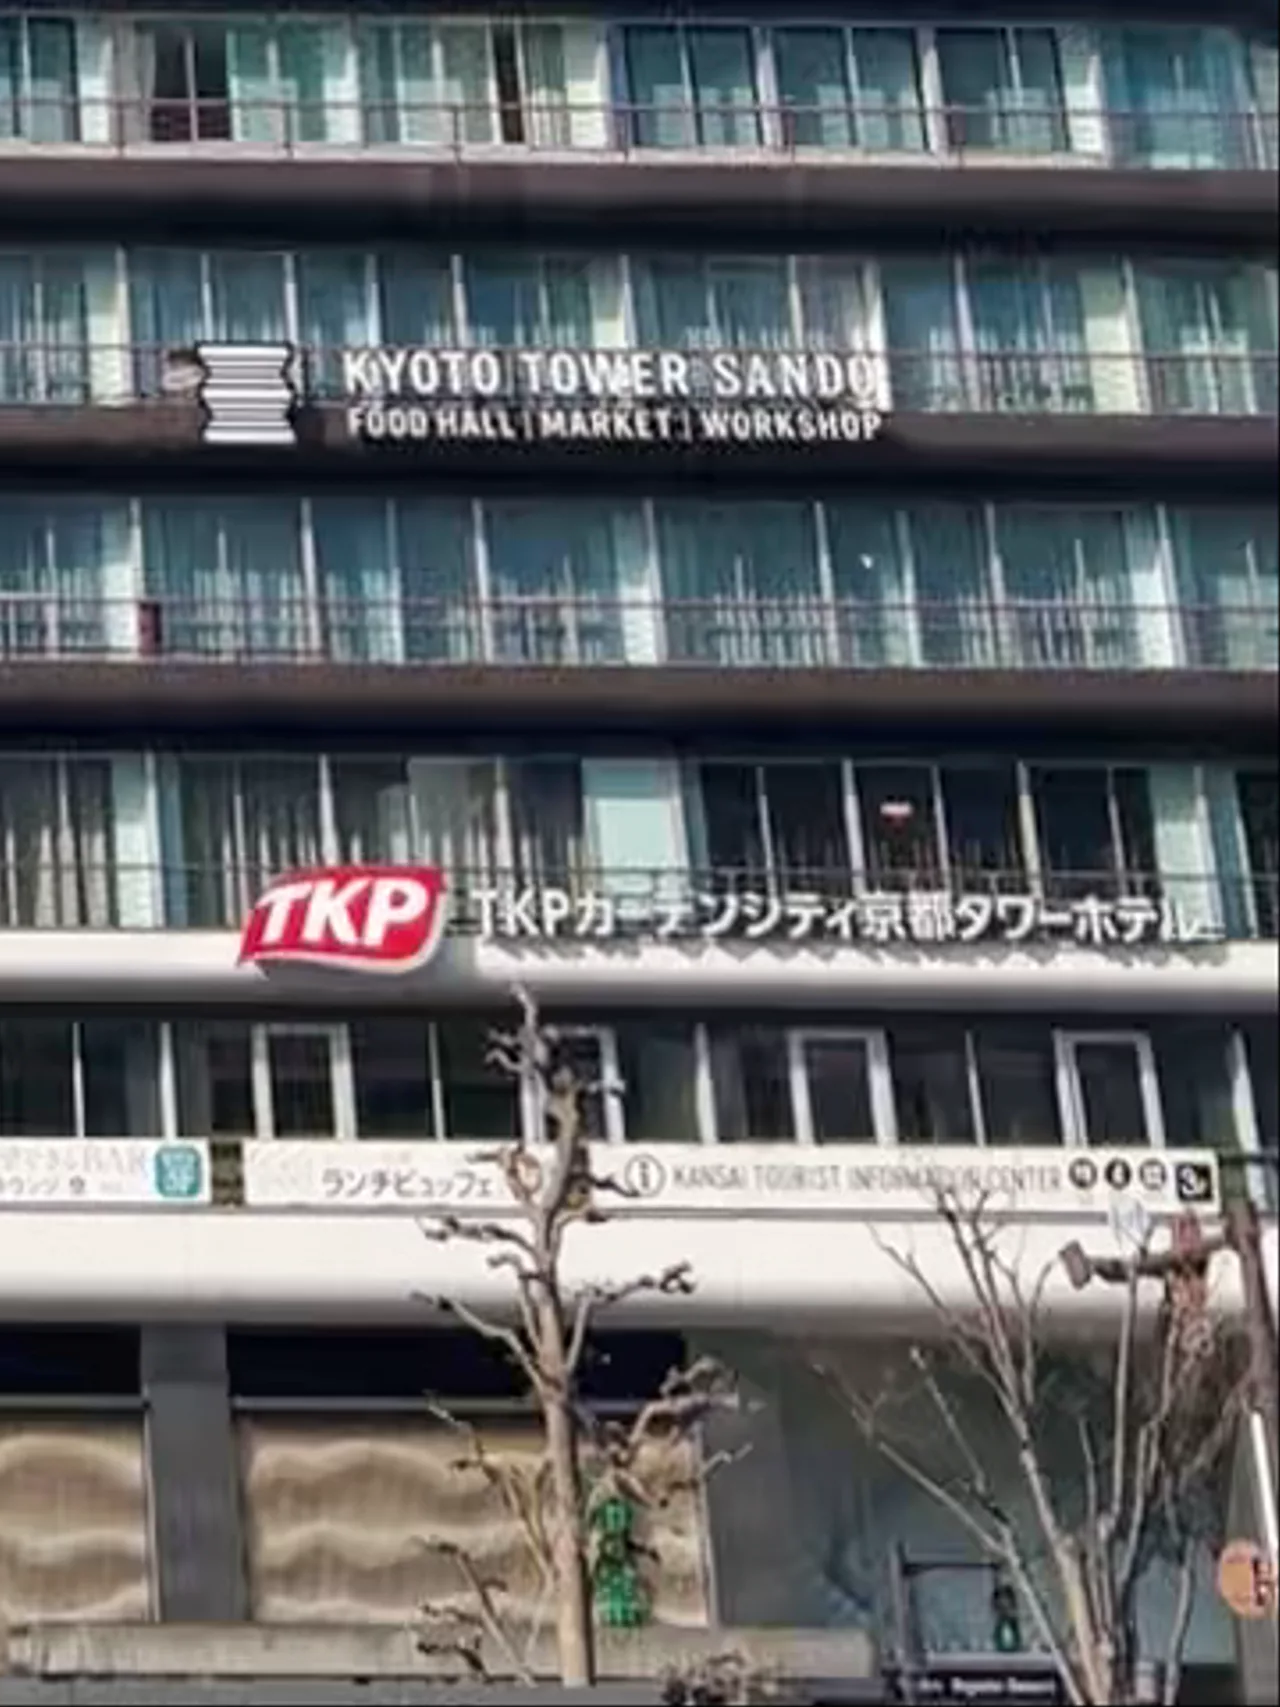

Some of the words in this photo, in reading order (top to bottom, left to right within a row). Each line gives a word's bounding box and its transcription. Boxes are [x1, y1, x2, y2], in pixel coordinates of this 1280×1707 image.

[344, 351, 500, 395] KYOTO
[518, 352, 689, 396] TOWER
[712, 353, 878, 398] SANDO
[348, 407, 428, 439] FOOD
[436, 408, 515, 440] HALL
[540, 409, 671, 441] MARKET
[700, 410, 879, 442] WORKSHOP
[254, 876, 429, 949] TKP
